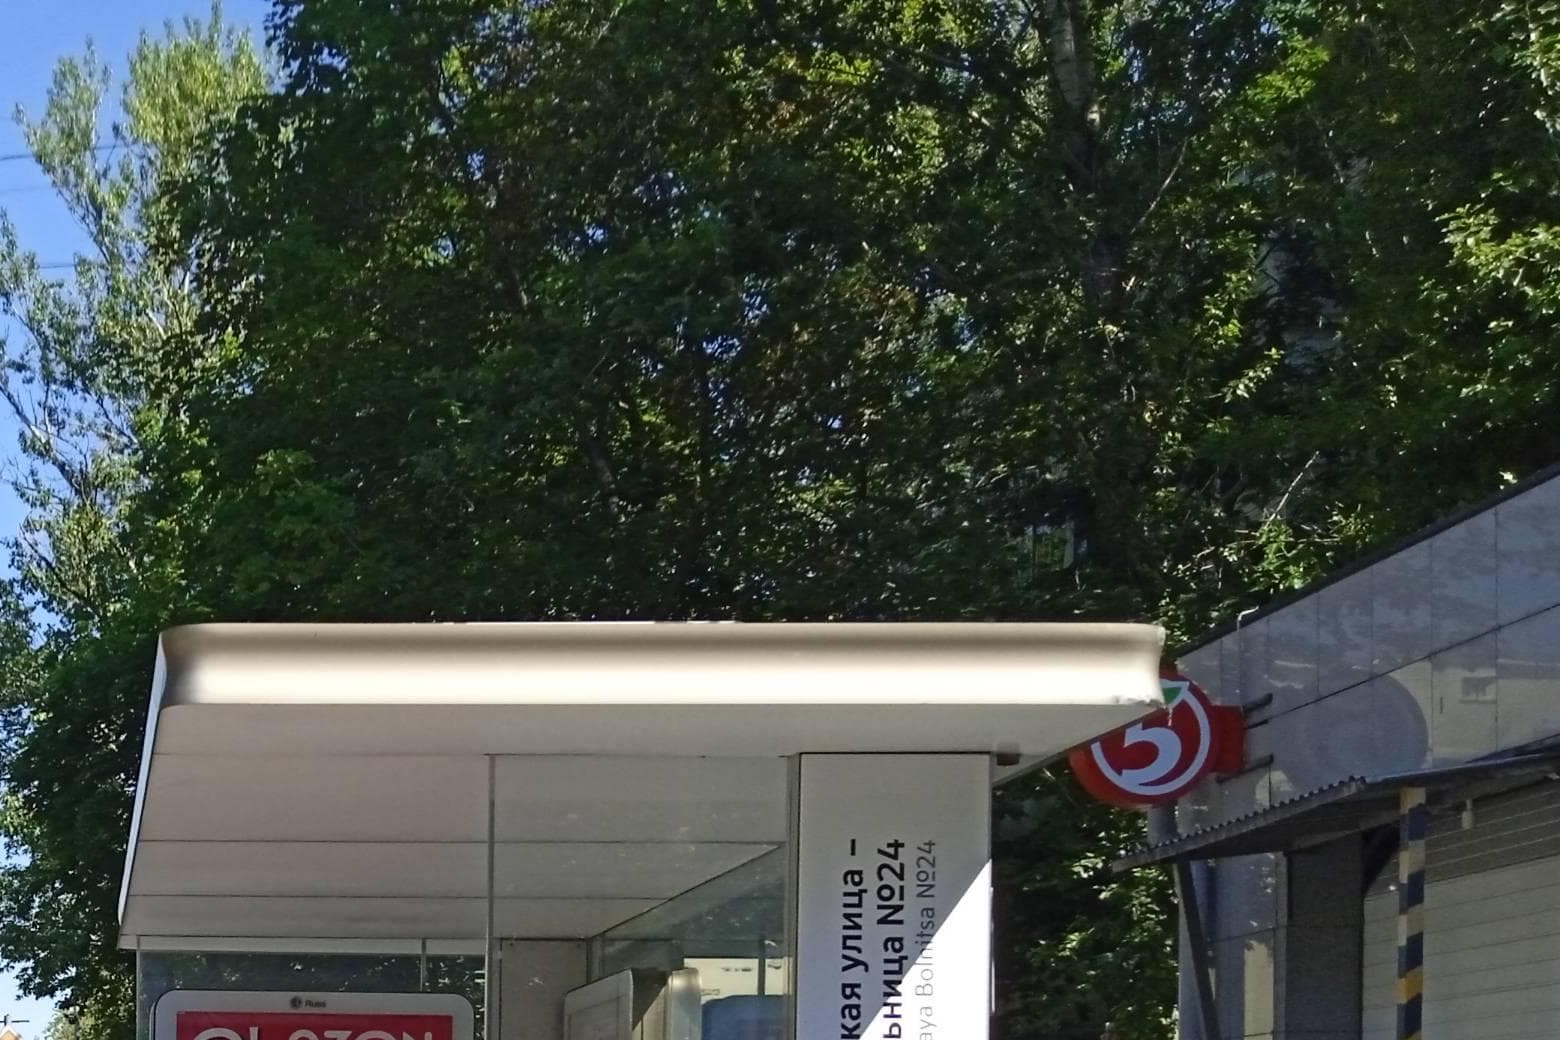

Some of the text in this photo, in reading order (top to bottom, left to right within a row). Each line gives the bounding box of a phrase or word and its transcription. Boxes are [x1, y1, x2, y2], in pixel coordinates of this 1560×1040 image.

[876, 838, 905, 926] №24
[916, 839, 937, 898] №24
[840, 868, 869, 974] улица
[913, 906, 936, 997] Bolnitsa
